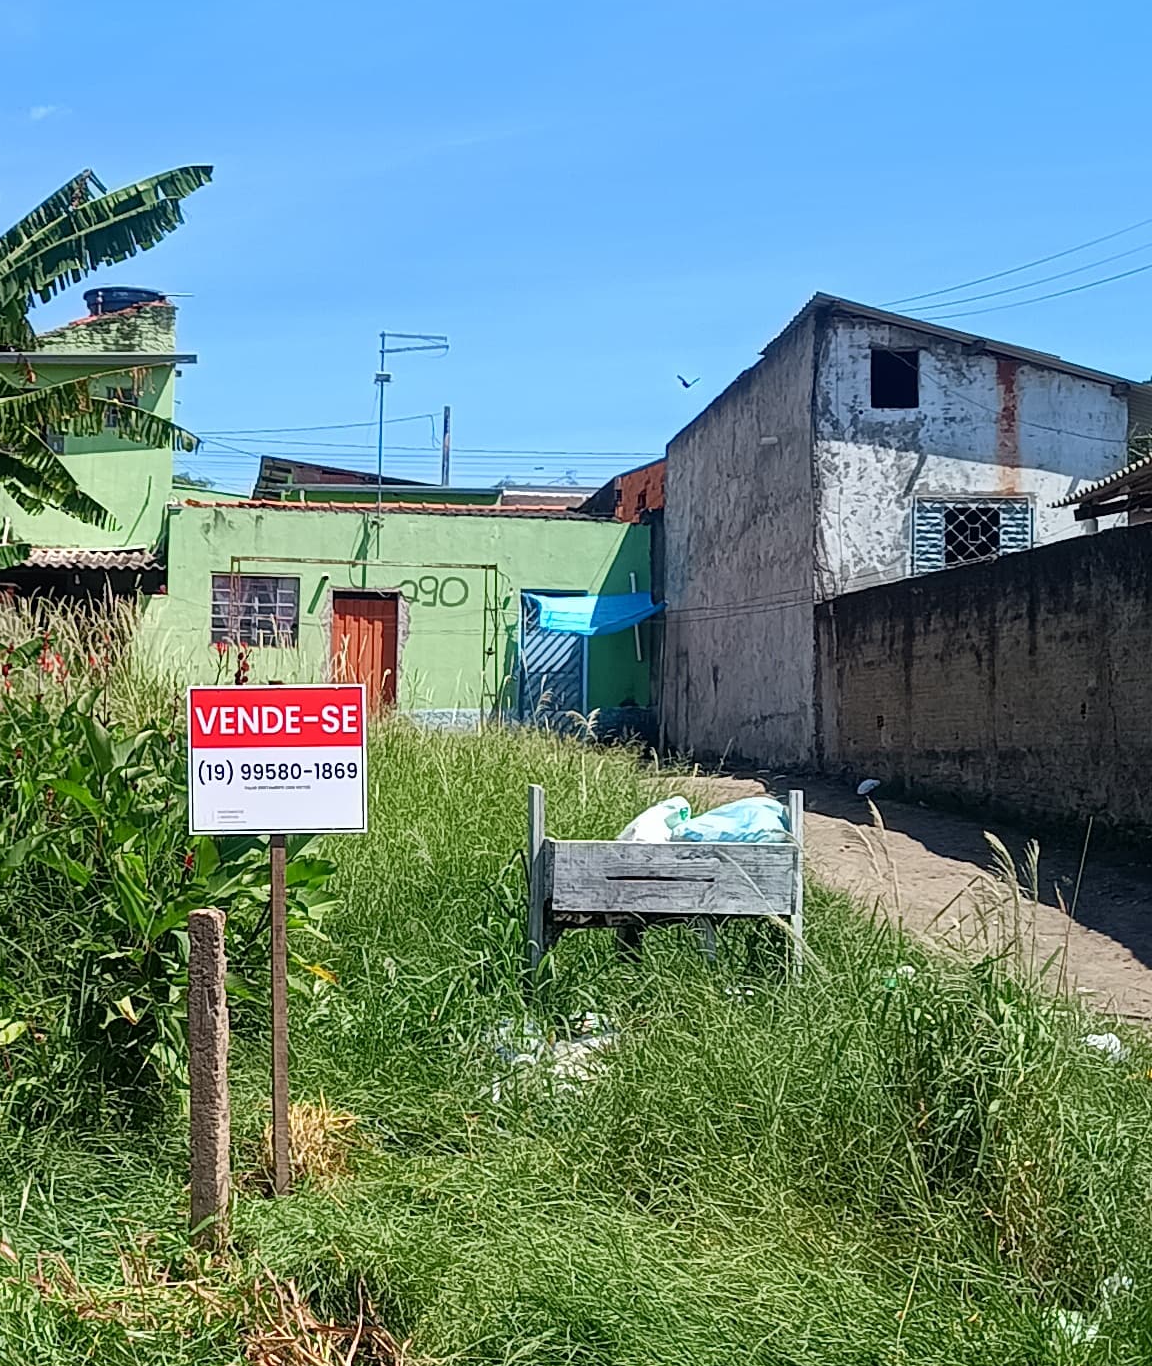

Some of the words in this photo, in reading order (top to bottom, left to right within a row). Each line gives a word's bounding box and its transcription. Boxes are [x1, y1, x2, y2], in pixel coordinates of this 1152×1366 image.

[196, 705, 358, 734] VENDE-SE
[198, 759, 234, 785] (19)
[240, 762, 358, 780] 99580-1869
